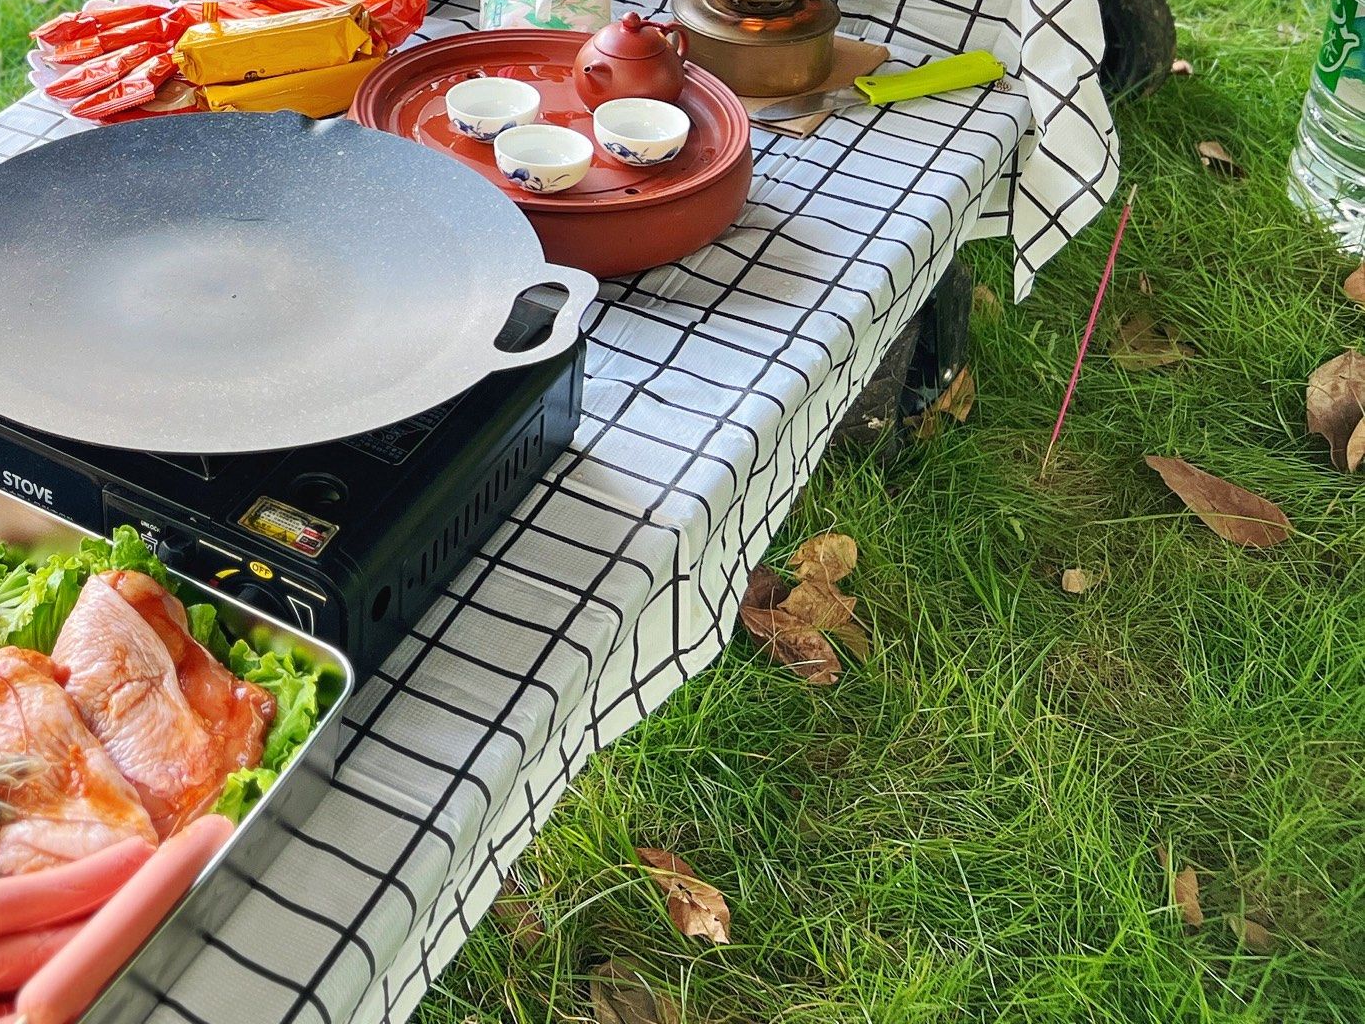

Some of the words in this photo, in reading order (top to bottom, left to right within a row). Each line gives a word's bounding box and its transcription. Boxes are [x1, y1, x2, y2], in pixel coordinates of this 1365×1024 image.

[2, 470, 53, 505] STOVE
[140, 520, 161, 533] UNLOCK
[251, 563, 271, 577] OFF
